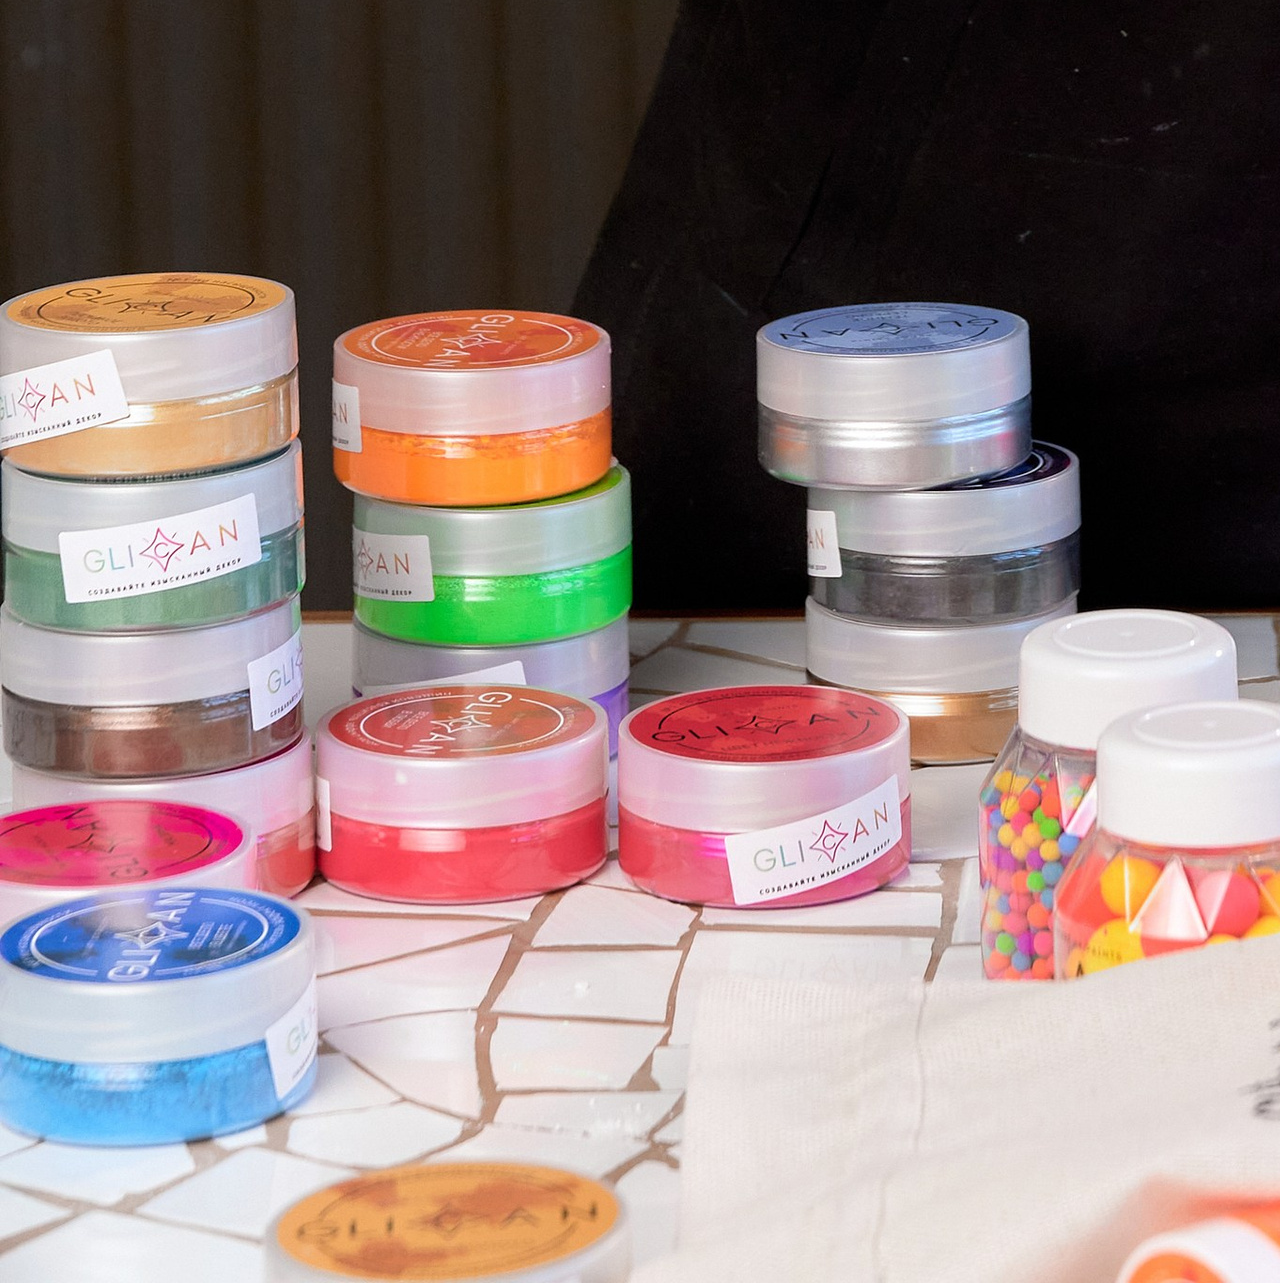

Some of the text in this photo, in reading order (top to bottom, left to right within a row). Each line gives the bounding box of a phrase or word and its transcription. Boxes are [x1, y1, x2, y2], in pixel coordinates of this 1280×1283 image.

[83, 520, 238, 573] GLICAN
[88, 557, 242, 596] СОЗДАВАЙТЕ ИЗЫСКАННЫЙ ДЕКОР
[753, 802, 888, 872] GLICAN
[759, 877, 815, 895] СОЗДАВАЙТЕ
[820, 852, 870, 878] ИЗЫСКАННЫЙ
